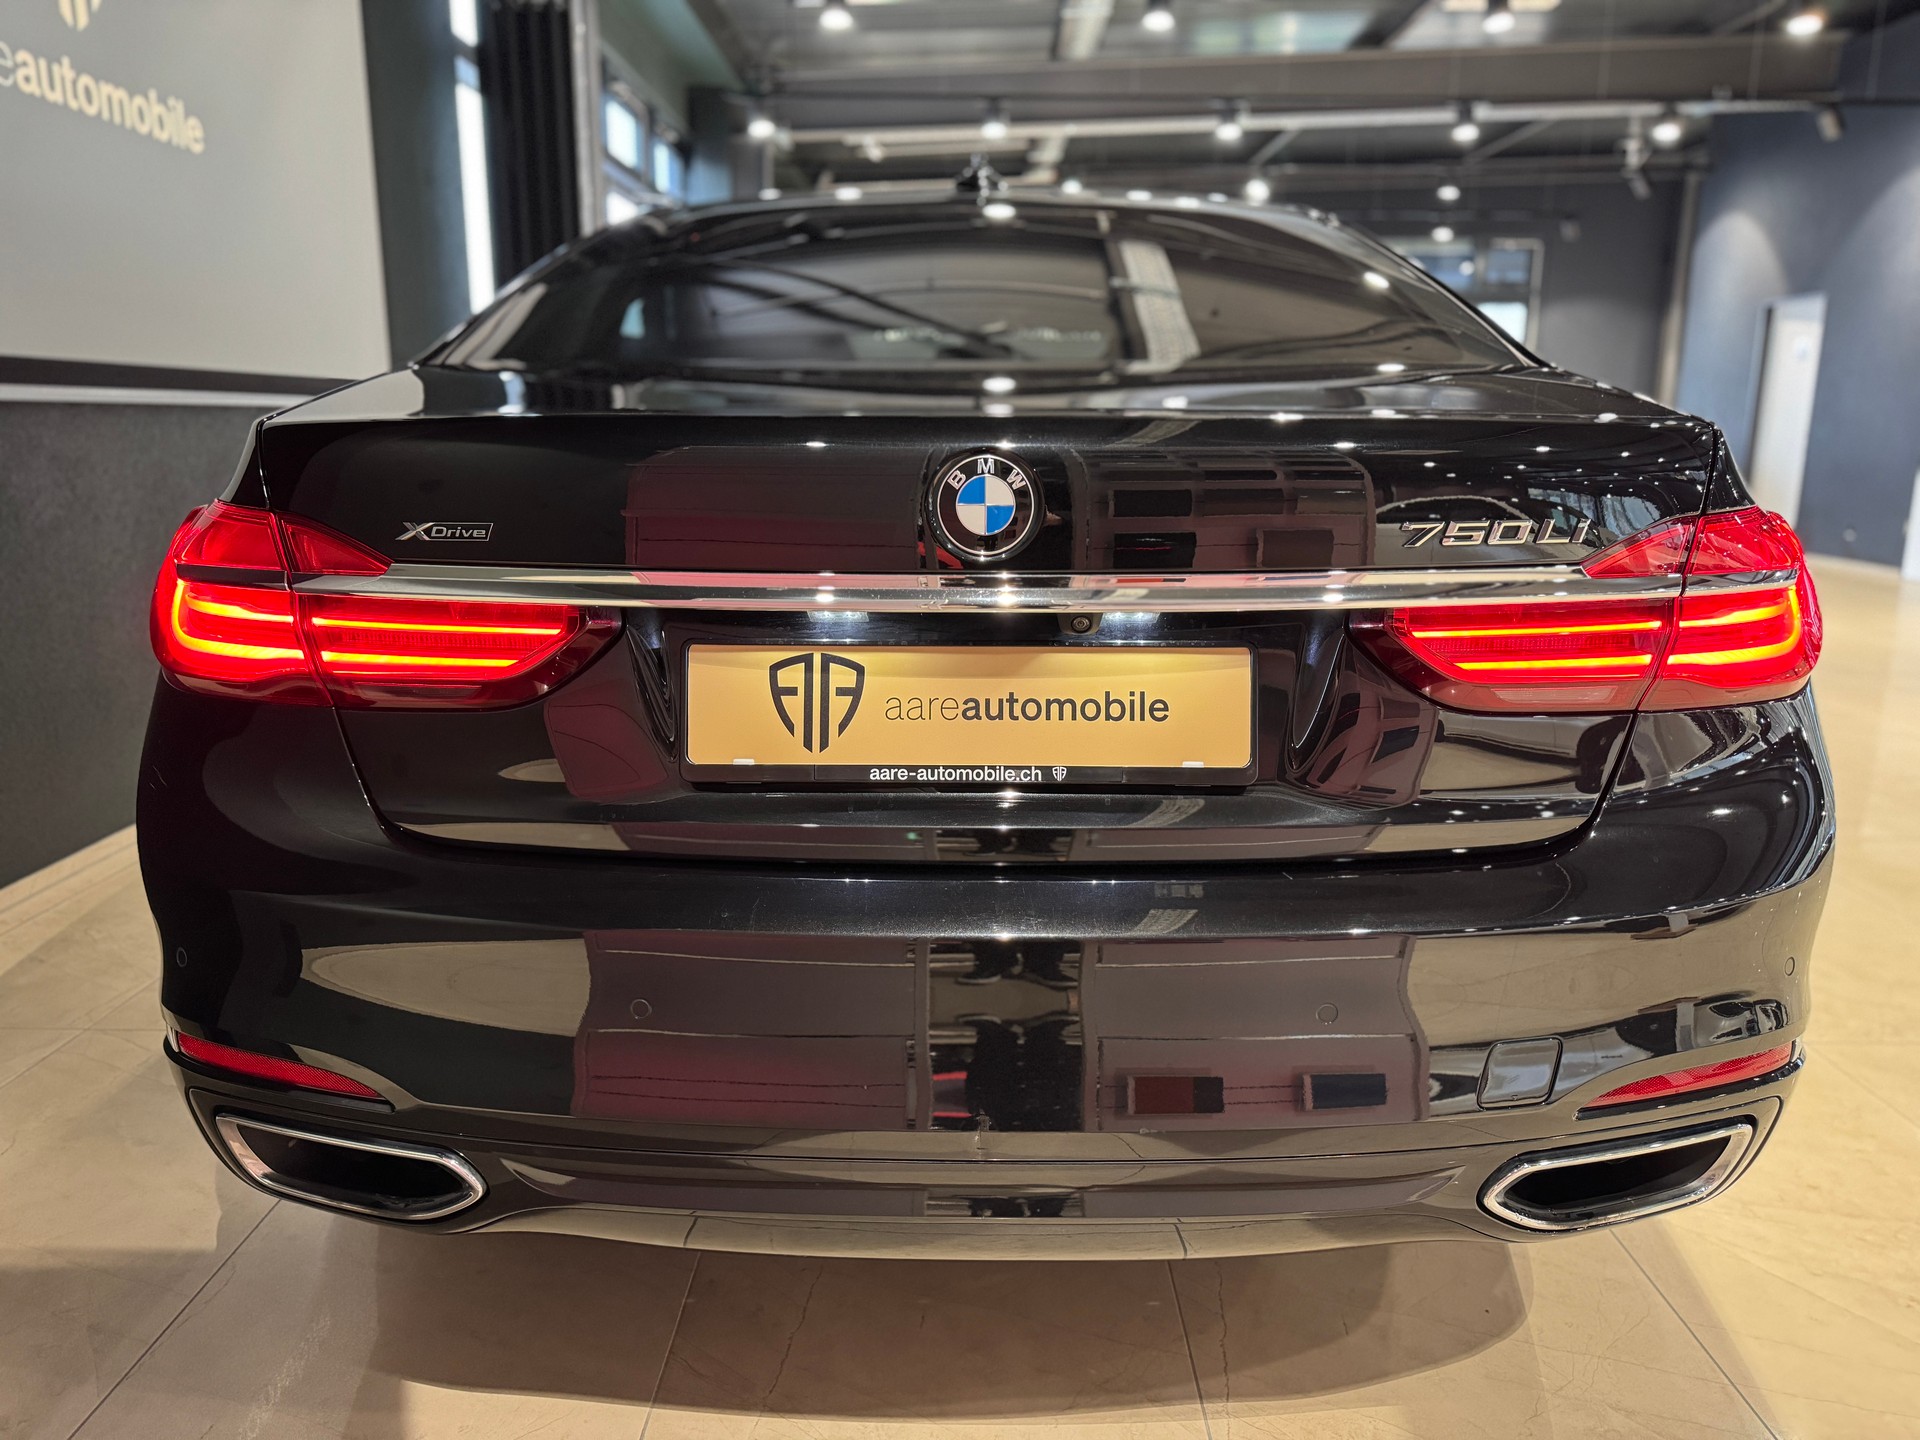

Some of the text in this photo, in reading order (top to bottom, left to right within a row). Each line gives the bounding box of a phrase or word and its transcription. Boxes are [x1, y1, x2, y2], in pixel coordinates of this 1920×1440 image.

[947, 457, 1027, 491] BMW
[884, 690, 1171, 723] aareautomobile
[869, 765, 1042, 782] aare-automobile.ch
